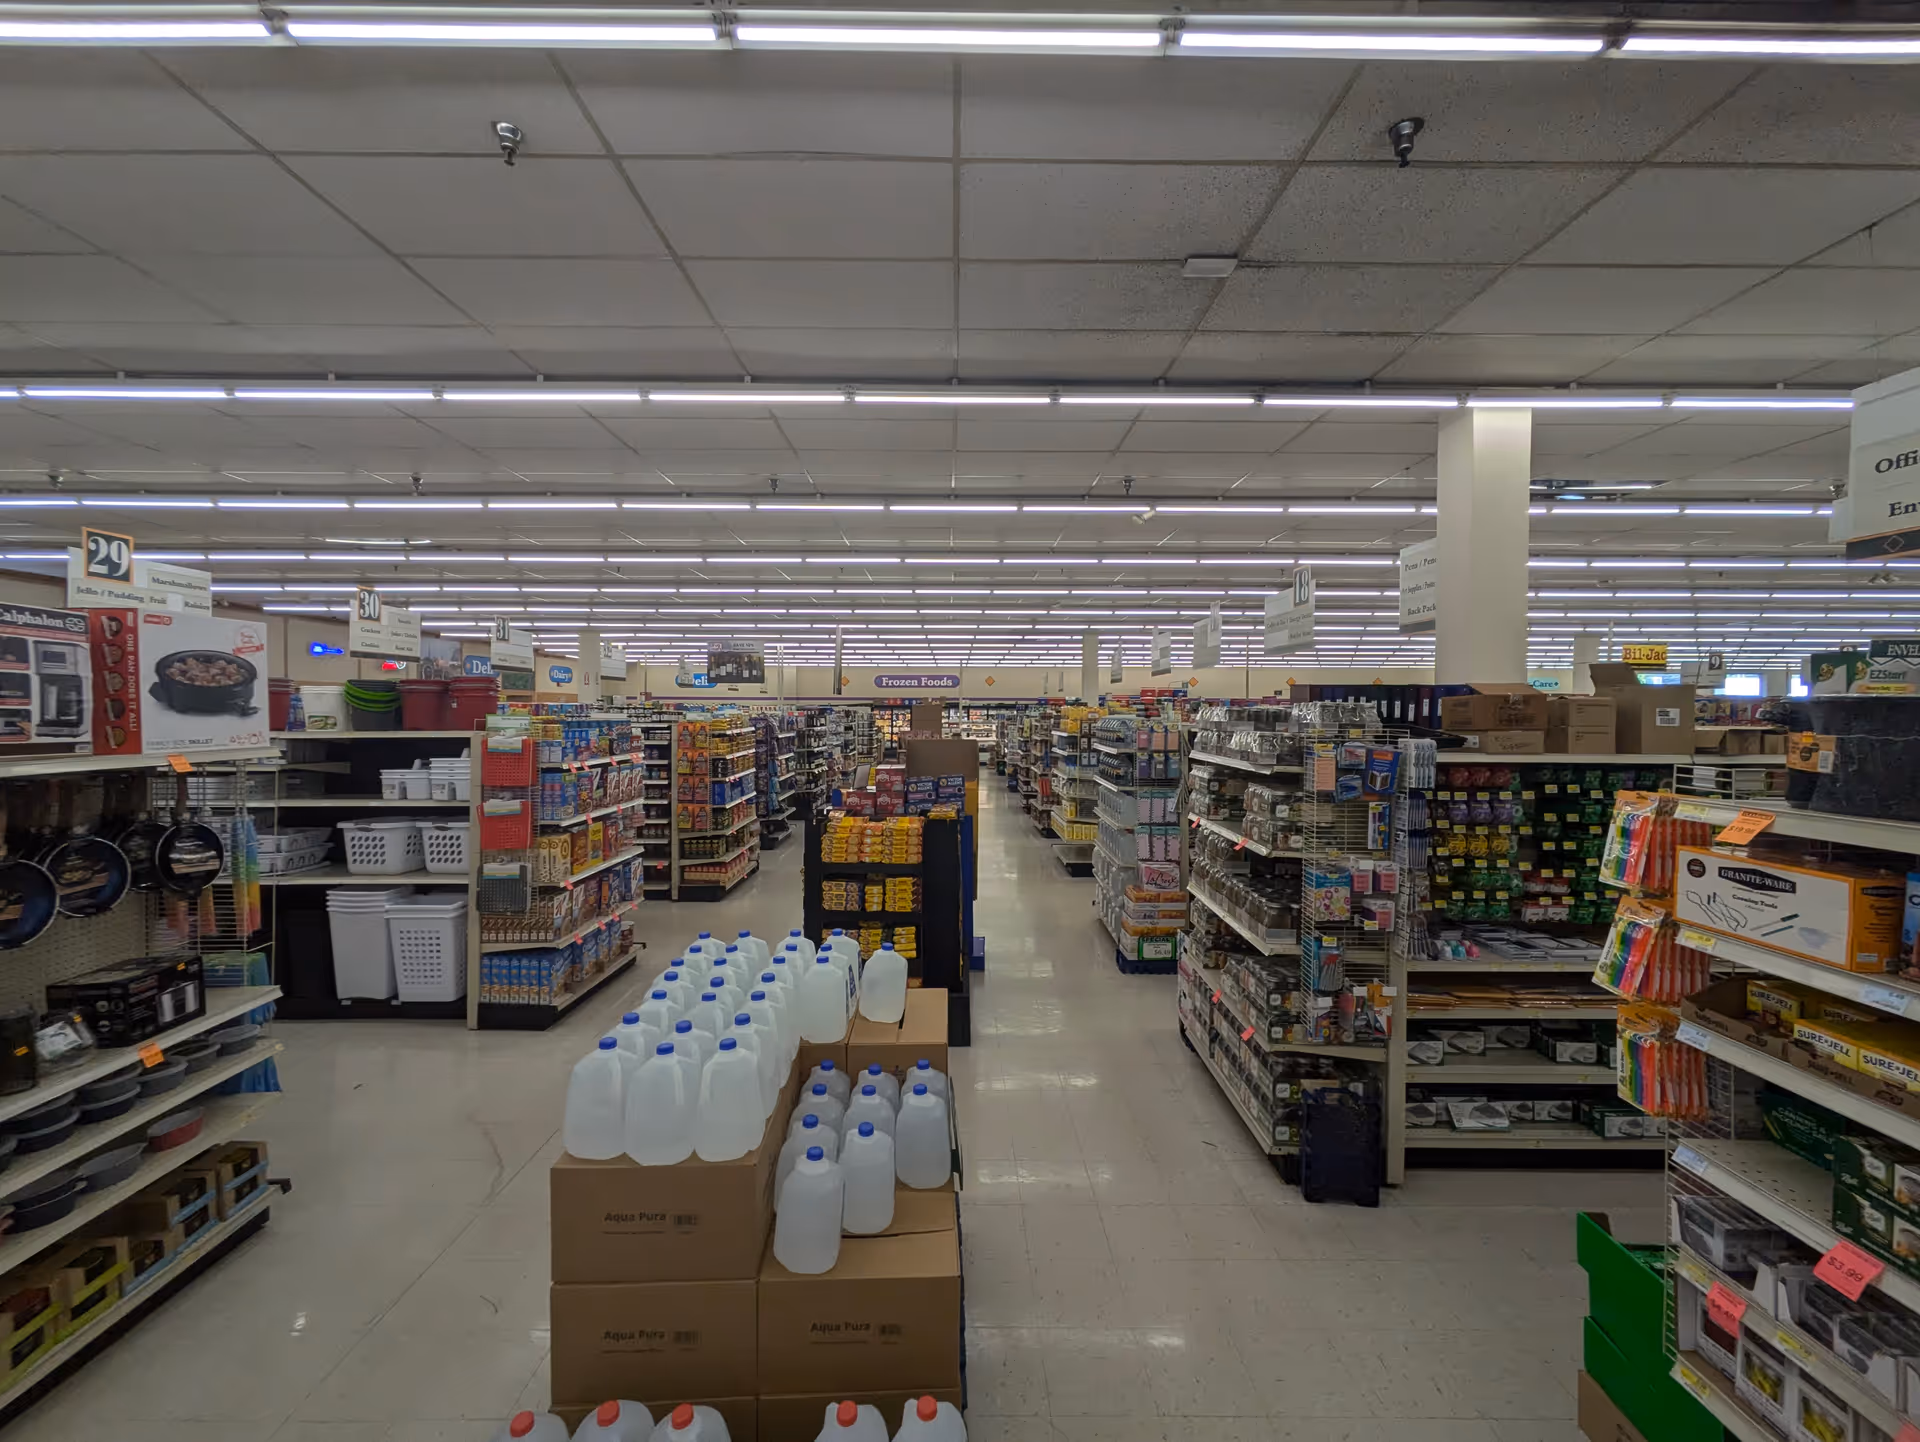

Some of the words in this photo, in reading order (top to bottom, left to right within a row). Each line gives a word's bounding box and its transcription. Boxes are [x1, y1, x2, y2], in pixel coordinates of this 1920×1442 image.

[1874, 449, 1920, 473] Offi
[1888, 501, 1920, 517] En
[88, 536, 130, 577] 29
[151, 576, 208, 592] Marshmallows
[1295, 570, 1309, 604] 18
[76, 586, 98, 596] Jello
[107, 590, 145, 603] Pudding
[150, 596, 167, 605] Fruit
[360, 591, 379, 619] 30
[1408, 606, 1421, 616] Back
[497, 619, 509, 640] 31
[127, 655, 135, 674] PAN
[472, 660, 493, 675] Del
[1711, 656, 1722, 669] 9
[553, 669, 569, 682] Dairy
[881, 677, 918, 686] Frozen
[920, 676, 953, 687] Foods
[1870, 669, 1905, 680] EZStart
[128, 676, 136, 700] DOES
[1533, 680, 1553, 688] Care
[129, 701, 136, 711] IT
[1721, 868, 1793, 892] GRANITE-WARE
[604, 1212, 635, 1224] Aqua
[638, 1210, 667, 1222] Pura
[604, 1330, 635, 1342] Aqua
[638, 1327, 666, 1341] Pura
[811, 1321, 841, 1335] Aqua
[844, 1319, 872, 1332] Pura
